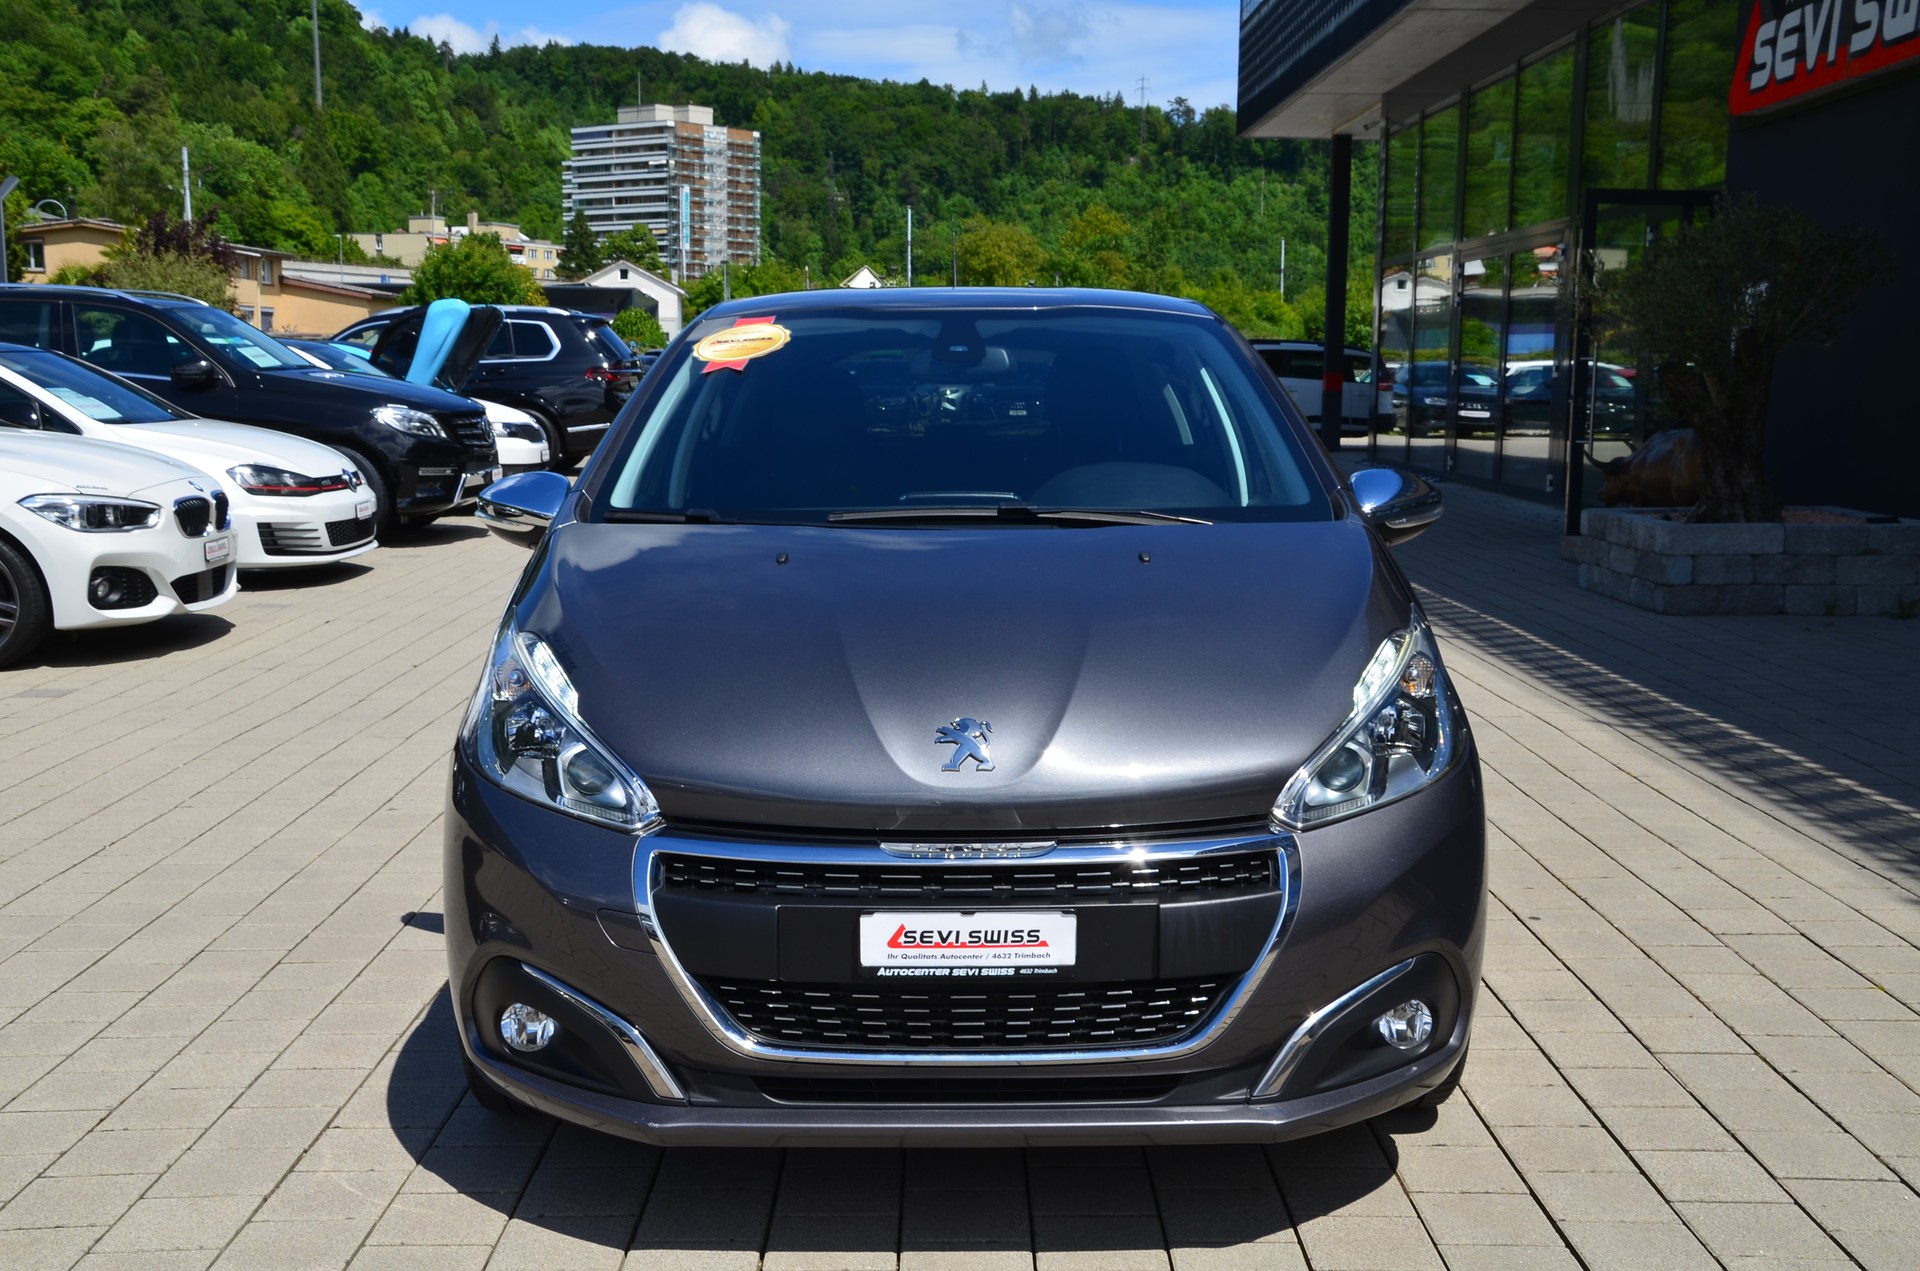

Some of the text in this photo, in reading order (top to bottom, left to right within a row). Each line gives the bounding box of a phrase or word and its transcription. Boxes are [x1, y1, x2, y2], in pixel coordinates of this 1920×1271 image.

[1749, 0, 1920, 91] SEVI SW
[903, 929, 1041, 945] SEVI SWISS
[1014, 952, 1051, 960] Trimbach
[877, 967, 950, 976] AUTOCENTER
[951, 967, 979, 976] SEVI
[980, 967, 1016, 976] SWISS
